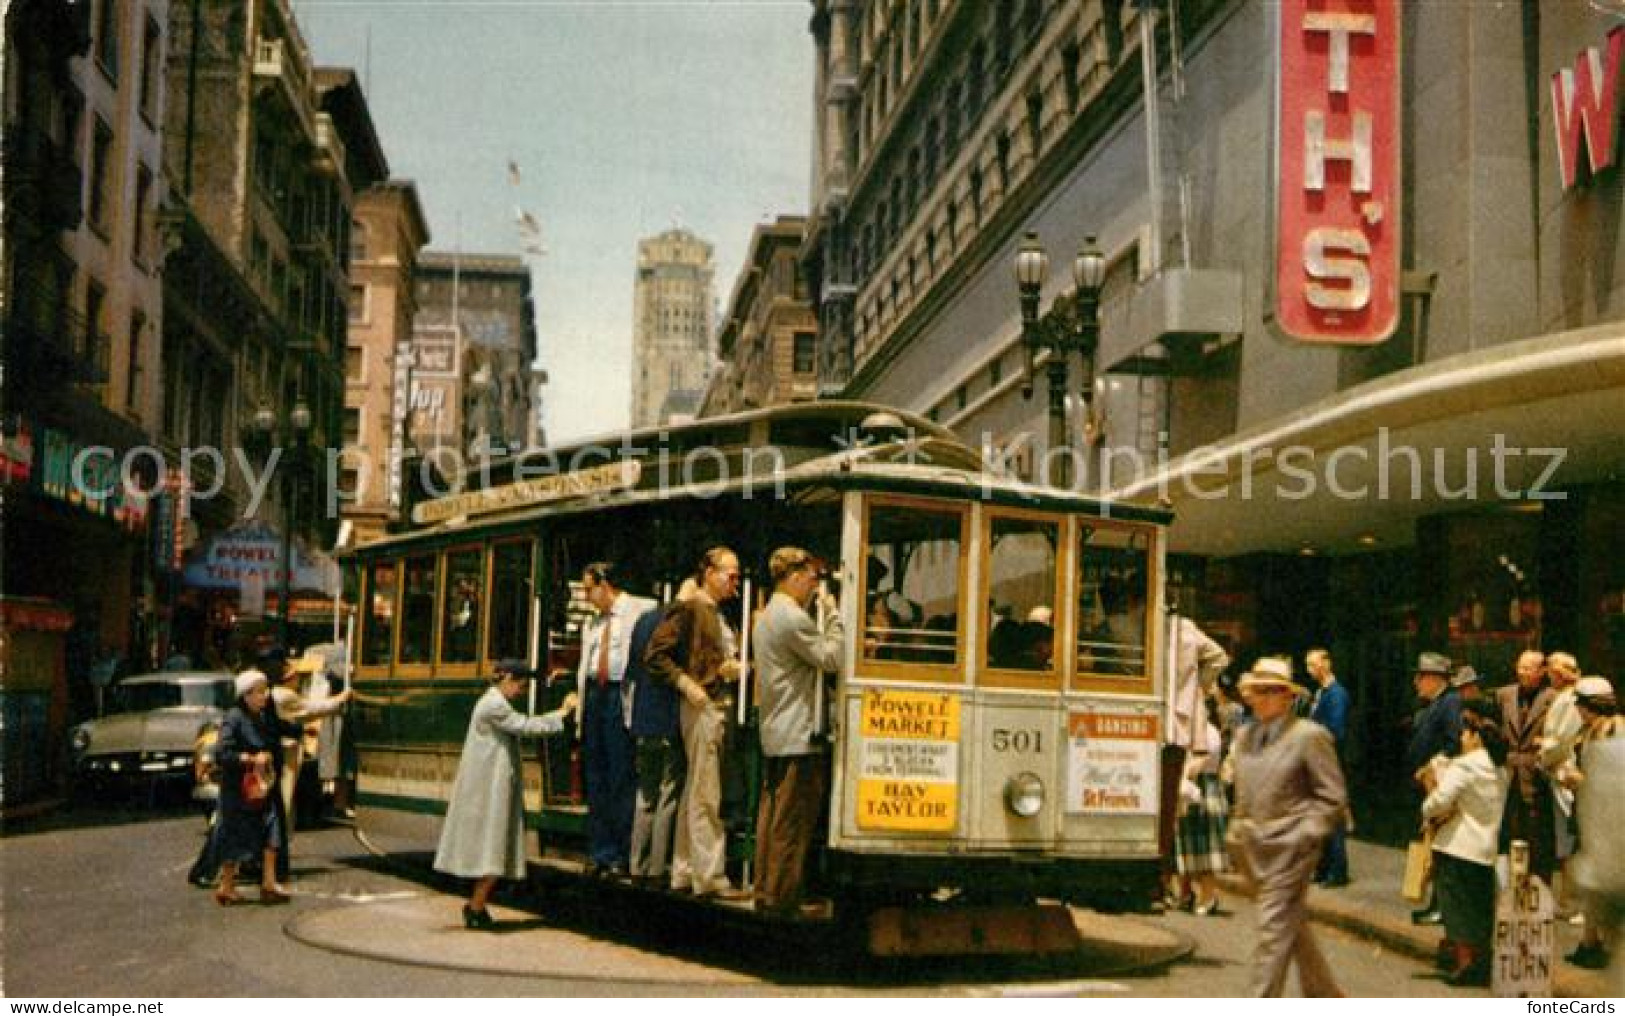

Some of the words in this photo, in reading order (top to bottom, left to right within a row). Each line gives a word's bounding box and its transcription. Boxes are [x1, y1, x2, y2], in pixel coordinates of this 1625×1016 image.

[870, 717, 951, 737] MARKET
[992, 728, 1042, 753] 501
[867, 800, 948, 817] TAYLOR
[1497, 919, 1553, 948] RIGHT
[1500, 954, 1549, 981] TURN
